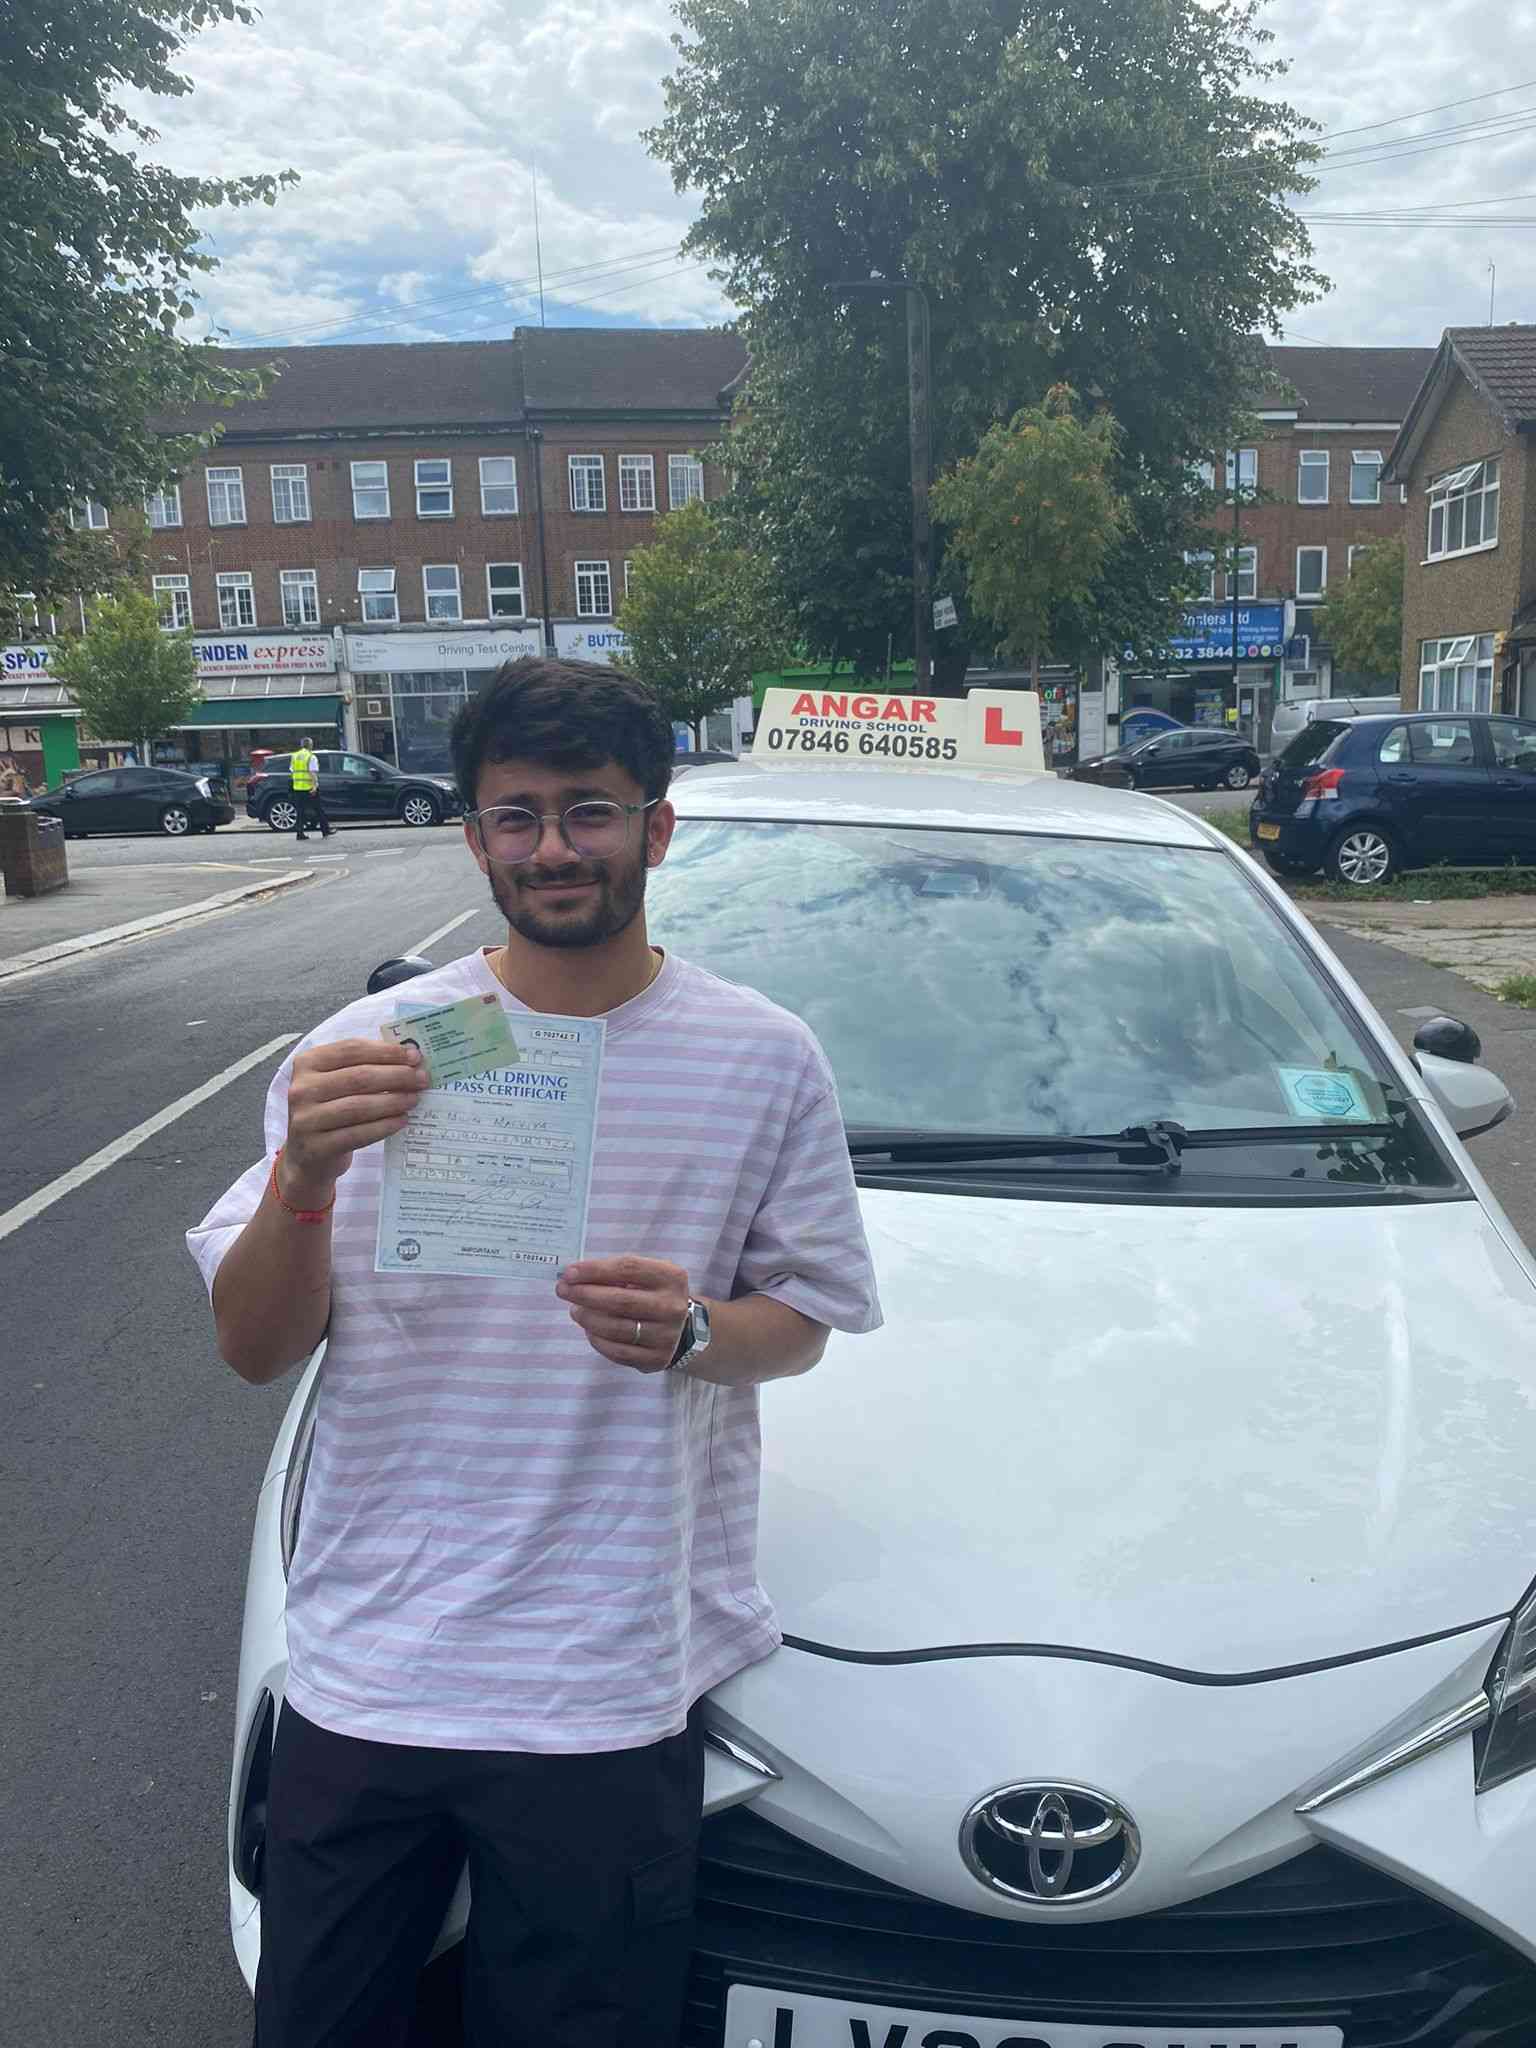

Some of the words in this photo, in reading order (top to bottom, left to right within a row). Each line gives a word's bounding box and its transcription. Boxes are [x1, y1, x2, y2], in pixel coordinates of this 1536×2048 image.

[192, 644, 248, 661] ENDEN
[254, 645, 325, 661] express
[438, 644, 473, 656] Driving
[477, 643, 498, 655] Test
[500, 642, 535, 654] Centre
[1197, 646, 1233, 658] 3844
[791, 693, 937, 722] ANGAR
[800, 718, 861, 730] DRIVING
[866, 721, 927, 733] SCHOOL
[985, 707, 1023, 746] L
[768, 728, 849, 753] 07846
[859, 733, 957, 760] 640585
[505, 1071, 568, 1088] DRIVING
[454, 1081, 484, 1094] PASS
[488, 1084, 567, 1101] CERTIFICATE
